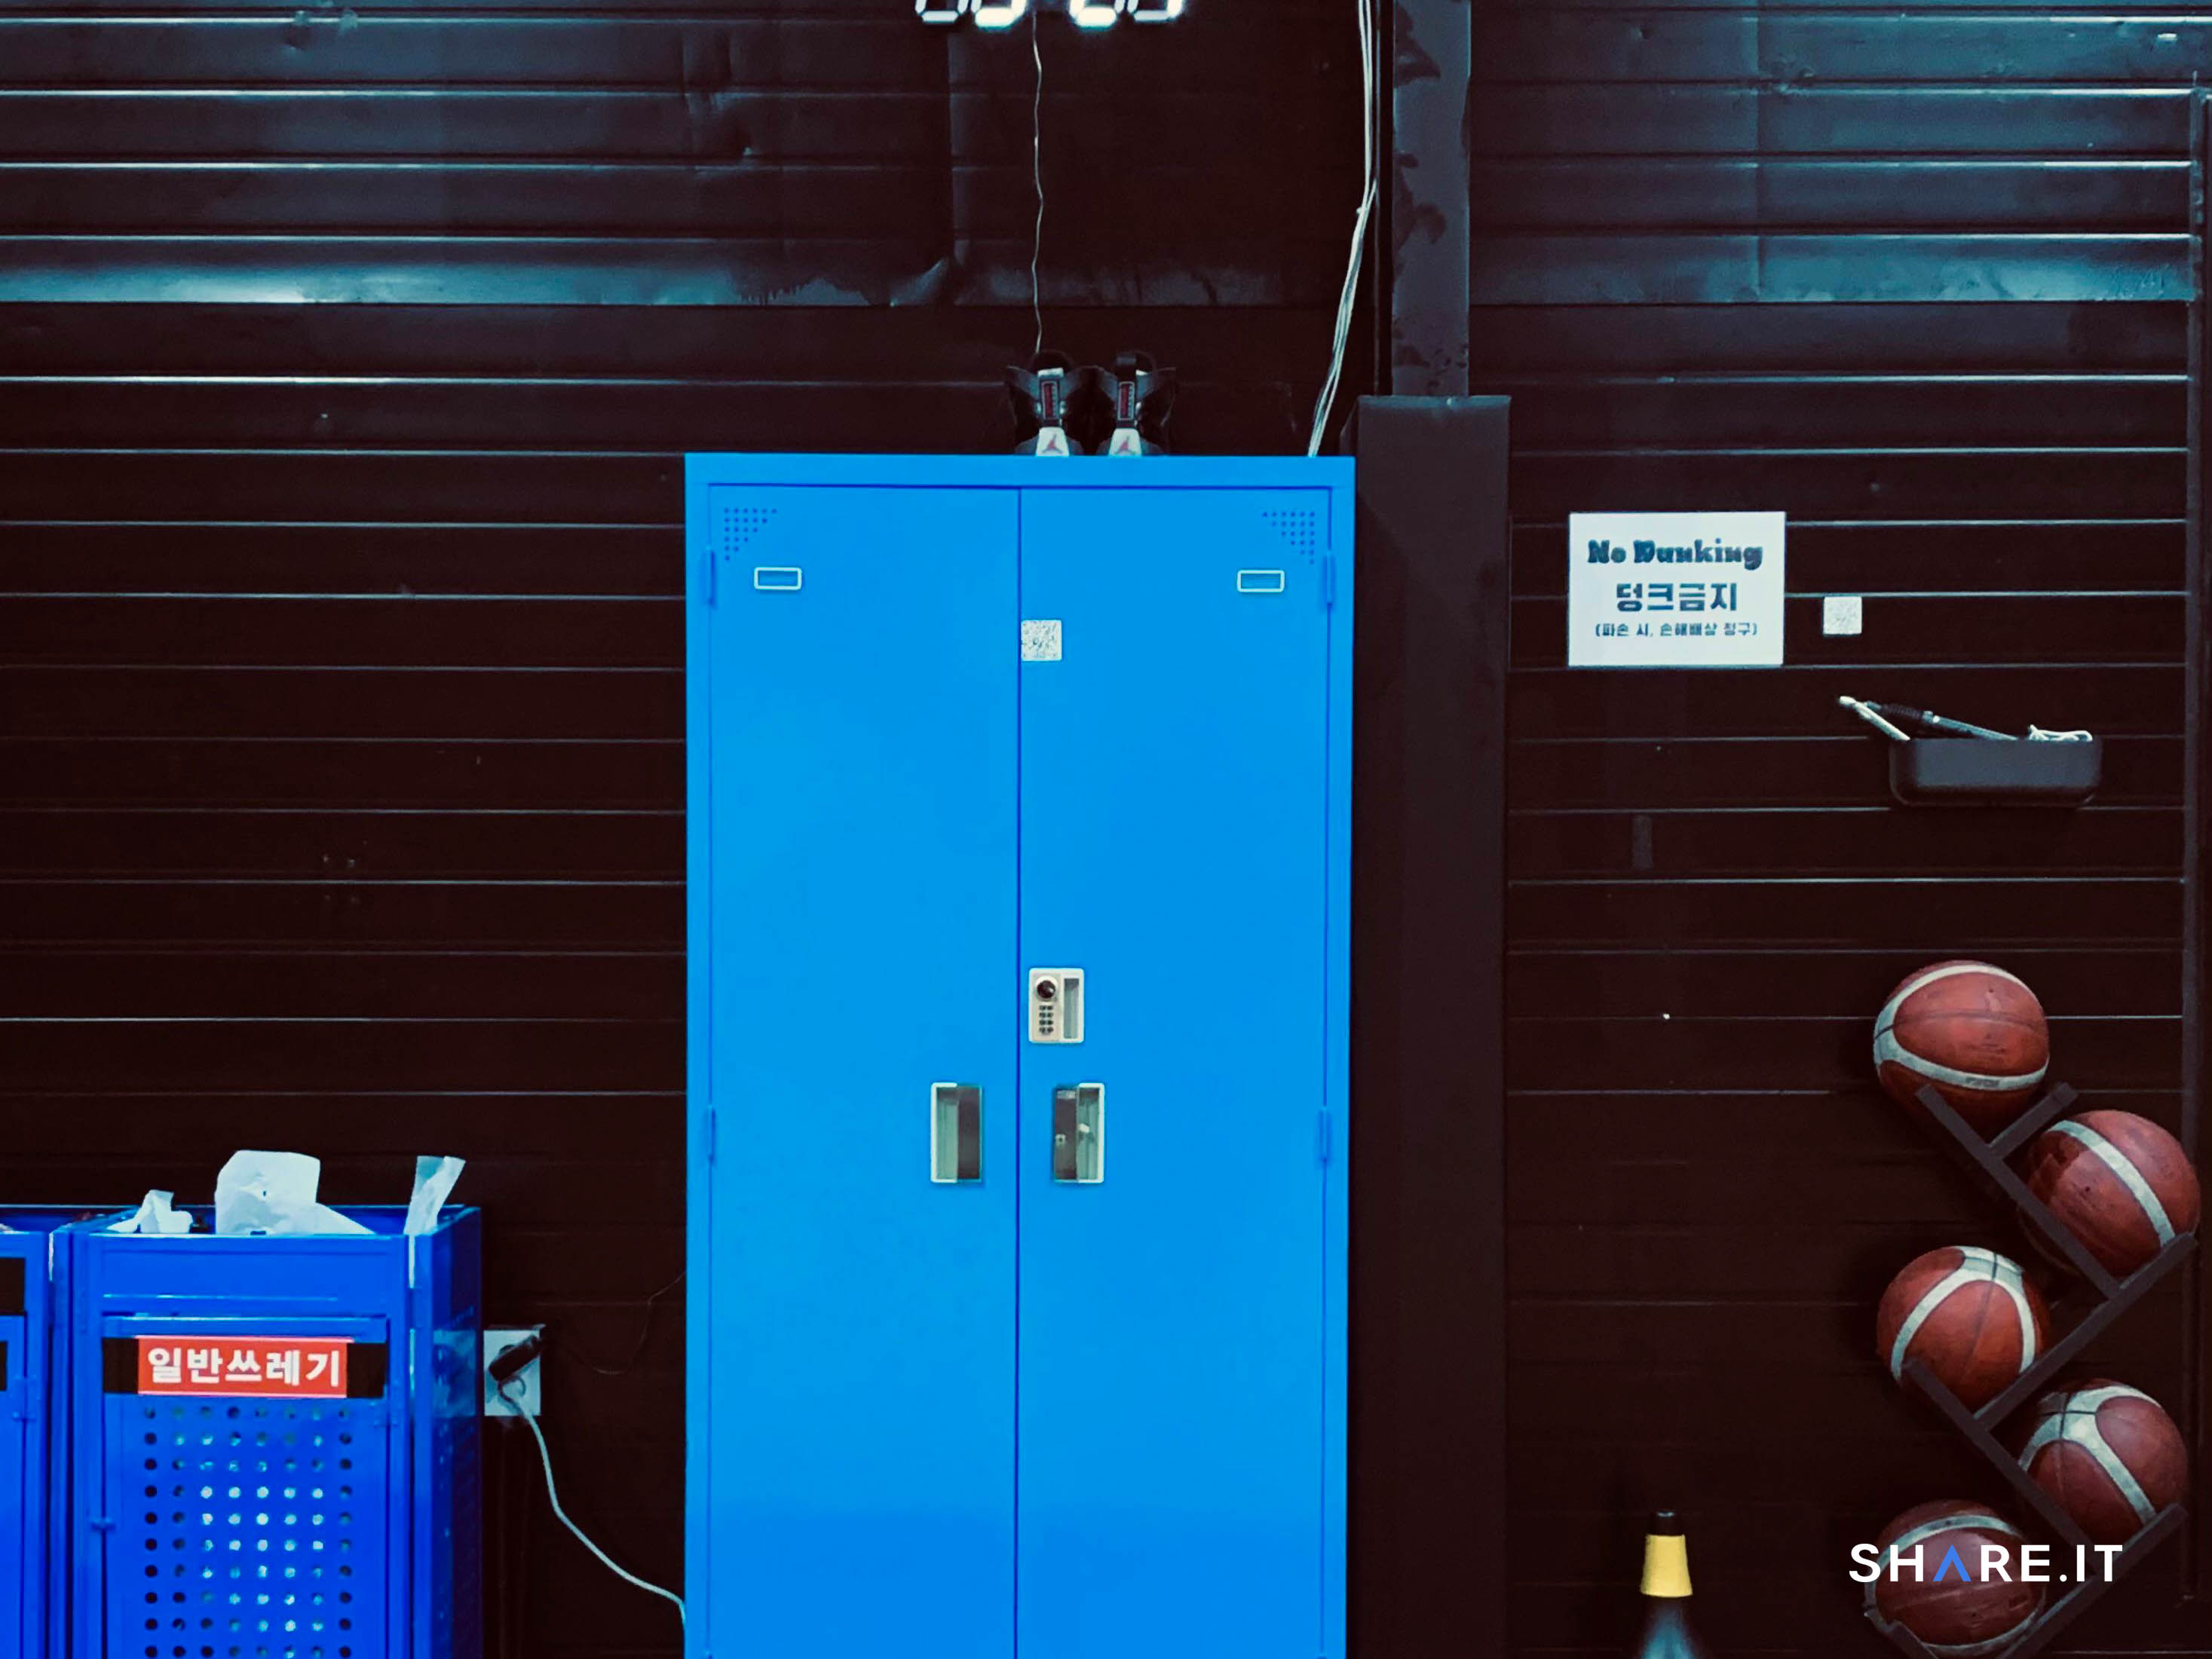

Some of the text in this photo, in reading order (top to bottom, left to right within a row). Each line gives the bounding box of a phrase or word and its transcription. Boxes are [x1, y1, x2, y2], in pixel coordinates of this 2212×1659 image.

[1587, 537, 1763, 571] No Dunking
[1616, 583, 1737, 612] 덩크금지
[1595, 623, 1629, 637] (파손
[1659, 623, 1718, 637] 손해배상
[148, 1347, 340, 1387] 일반쓰레기
